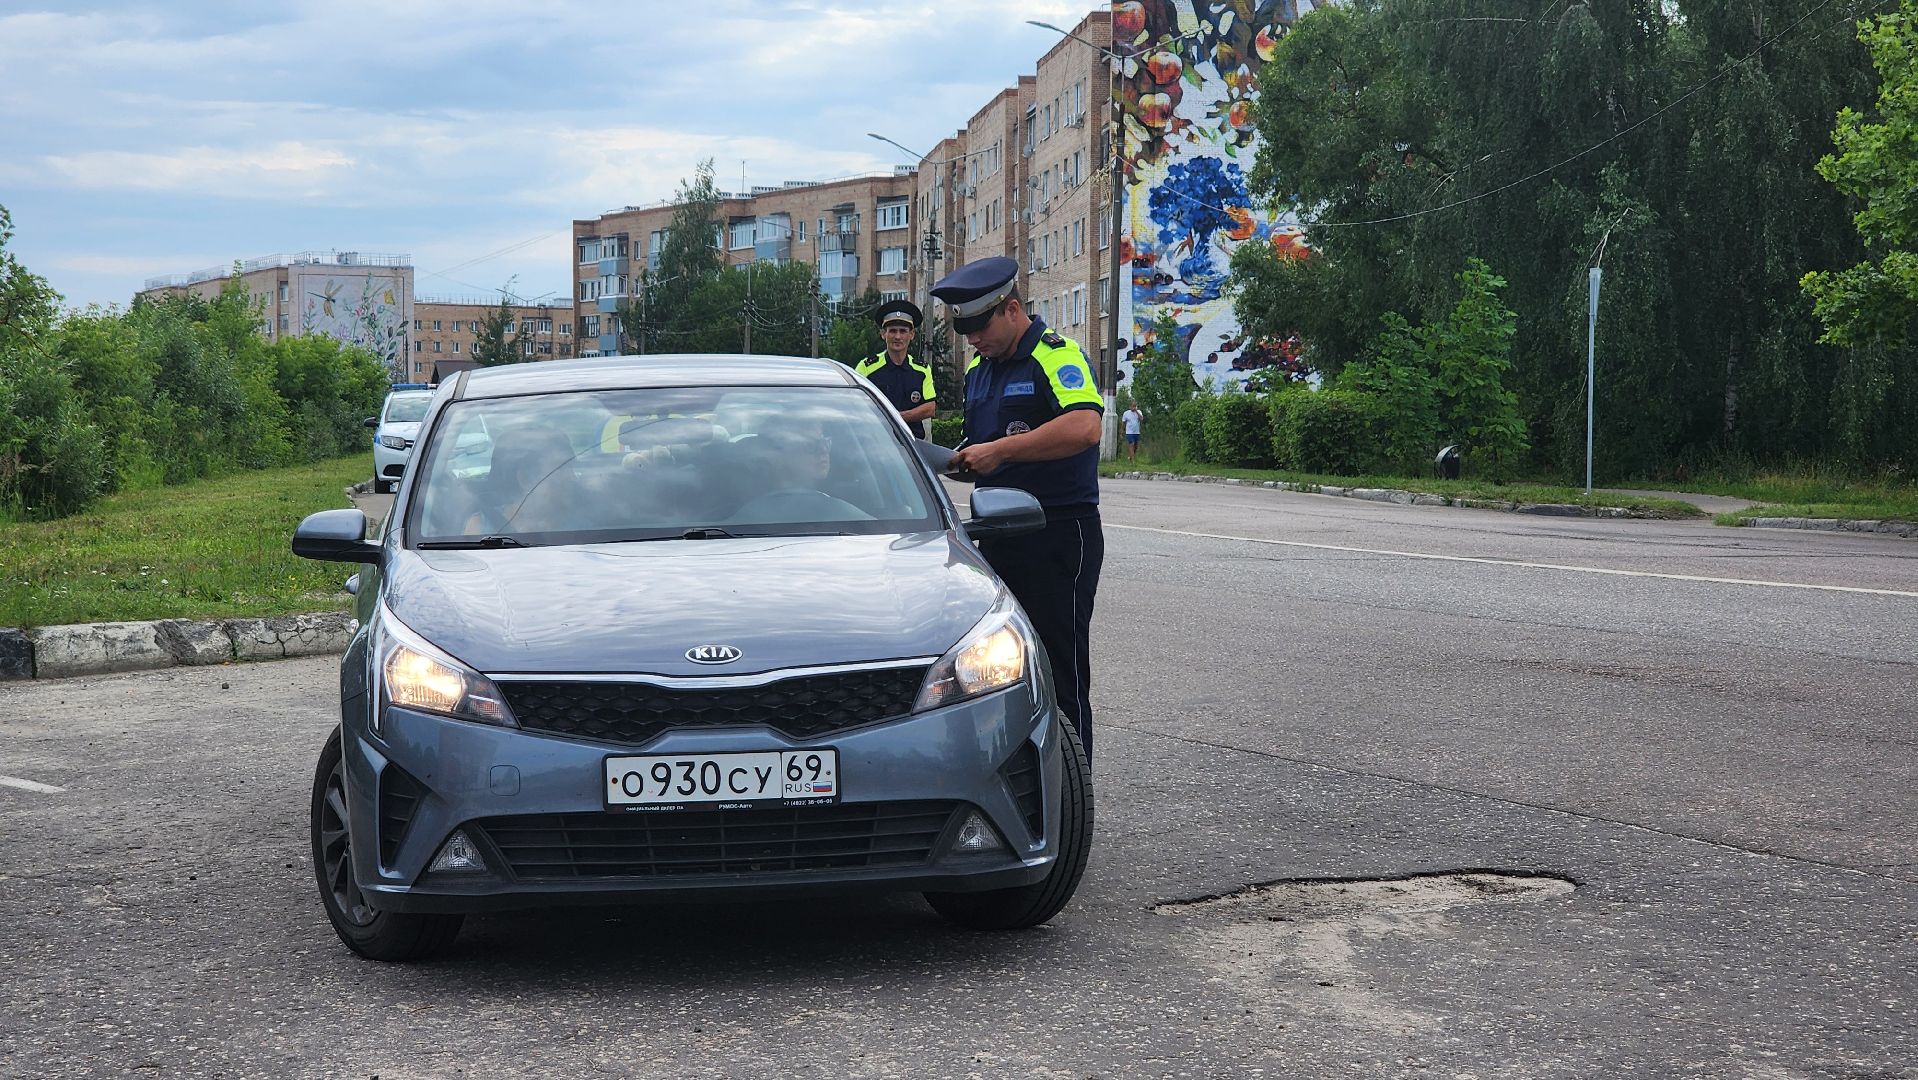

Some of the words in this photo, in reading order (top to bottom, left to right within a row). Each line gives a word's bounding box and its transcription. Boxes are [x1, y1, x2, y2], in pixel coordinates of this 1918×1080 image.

[694, 646, 734, 659] KIA
[786, 754, 822, 782] 69
[785, 783, 812, 794] RUS
